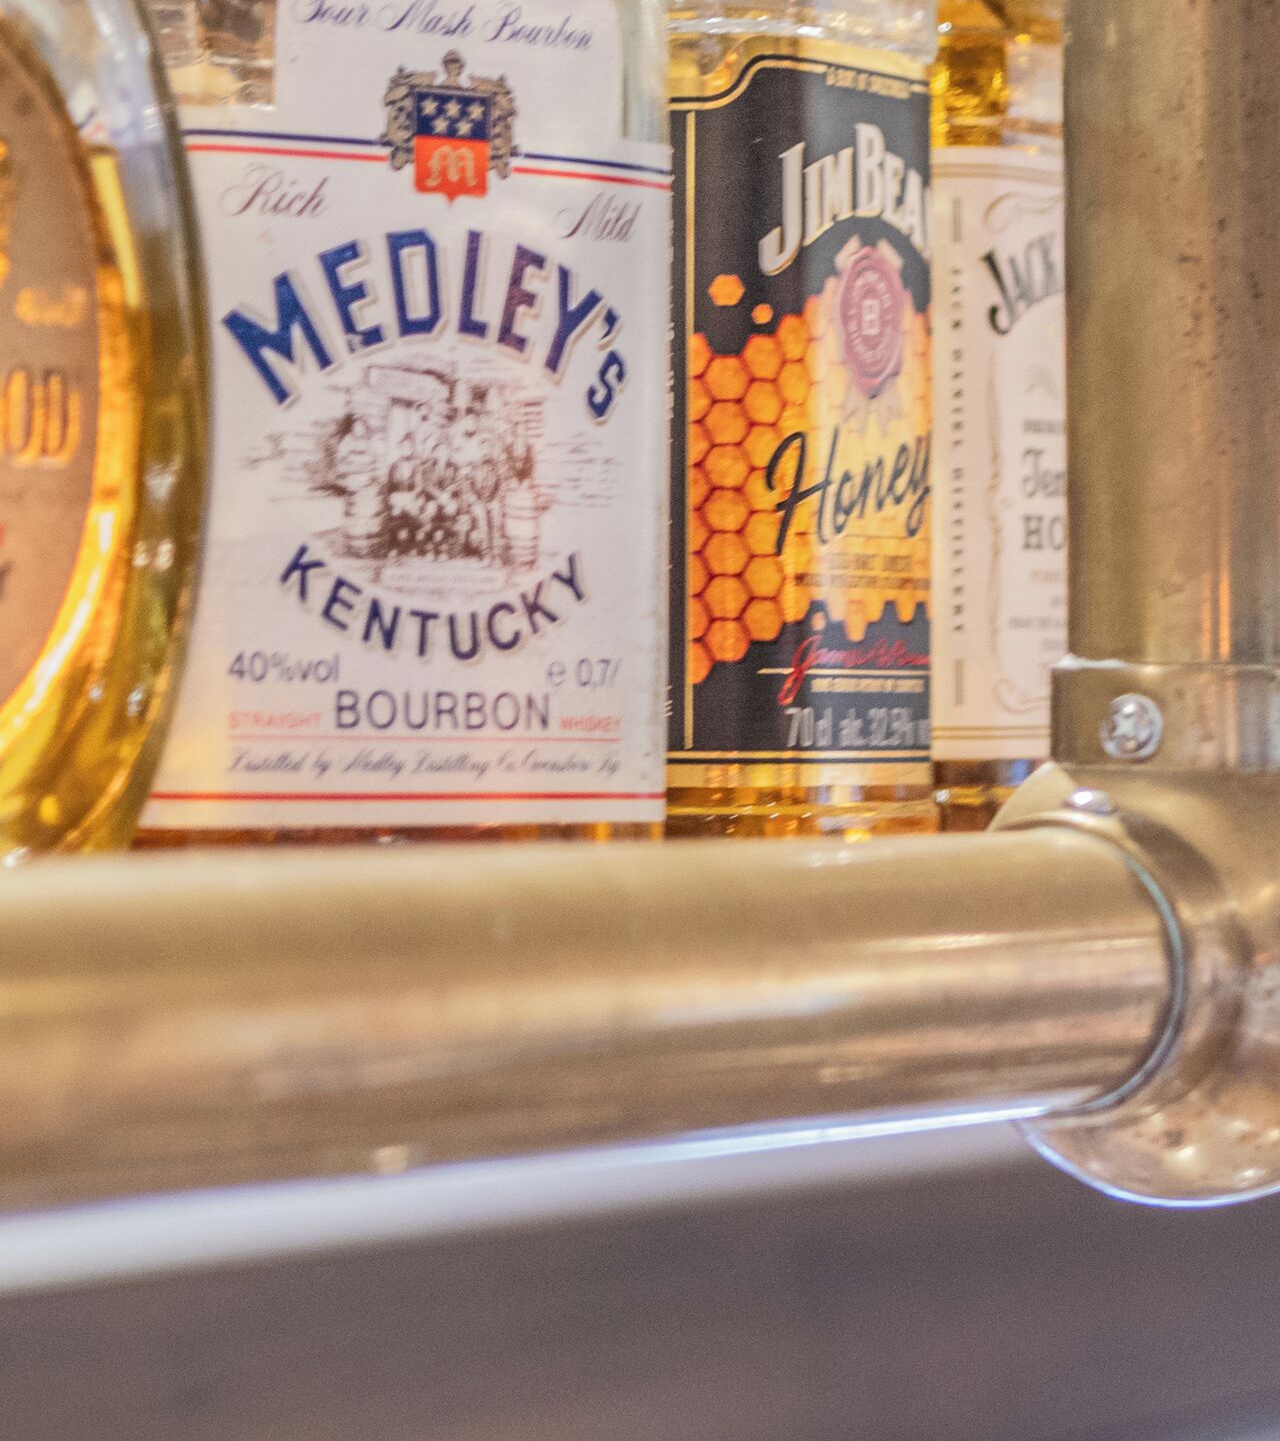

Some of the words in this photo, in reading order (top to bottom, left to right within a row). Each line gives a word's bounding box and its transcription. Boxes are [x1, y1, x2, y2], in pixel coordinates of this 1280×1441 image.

[480, 1, 594, 51] Bourbon
[222, 162, 332, 220] Rich
[555, 190, 643, 243] Mild
[854, 121, 933, 255] BEA
[223, 229, 628, 419] MEDLEY'S
[764, 424, 933, 557] Honey
[279, 543, 589, 662] KENTUCKY
[334, 689, 551, 731] BOURBON
